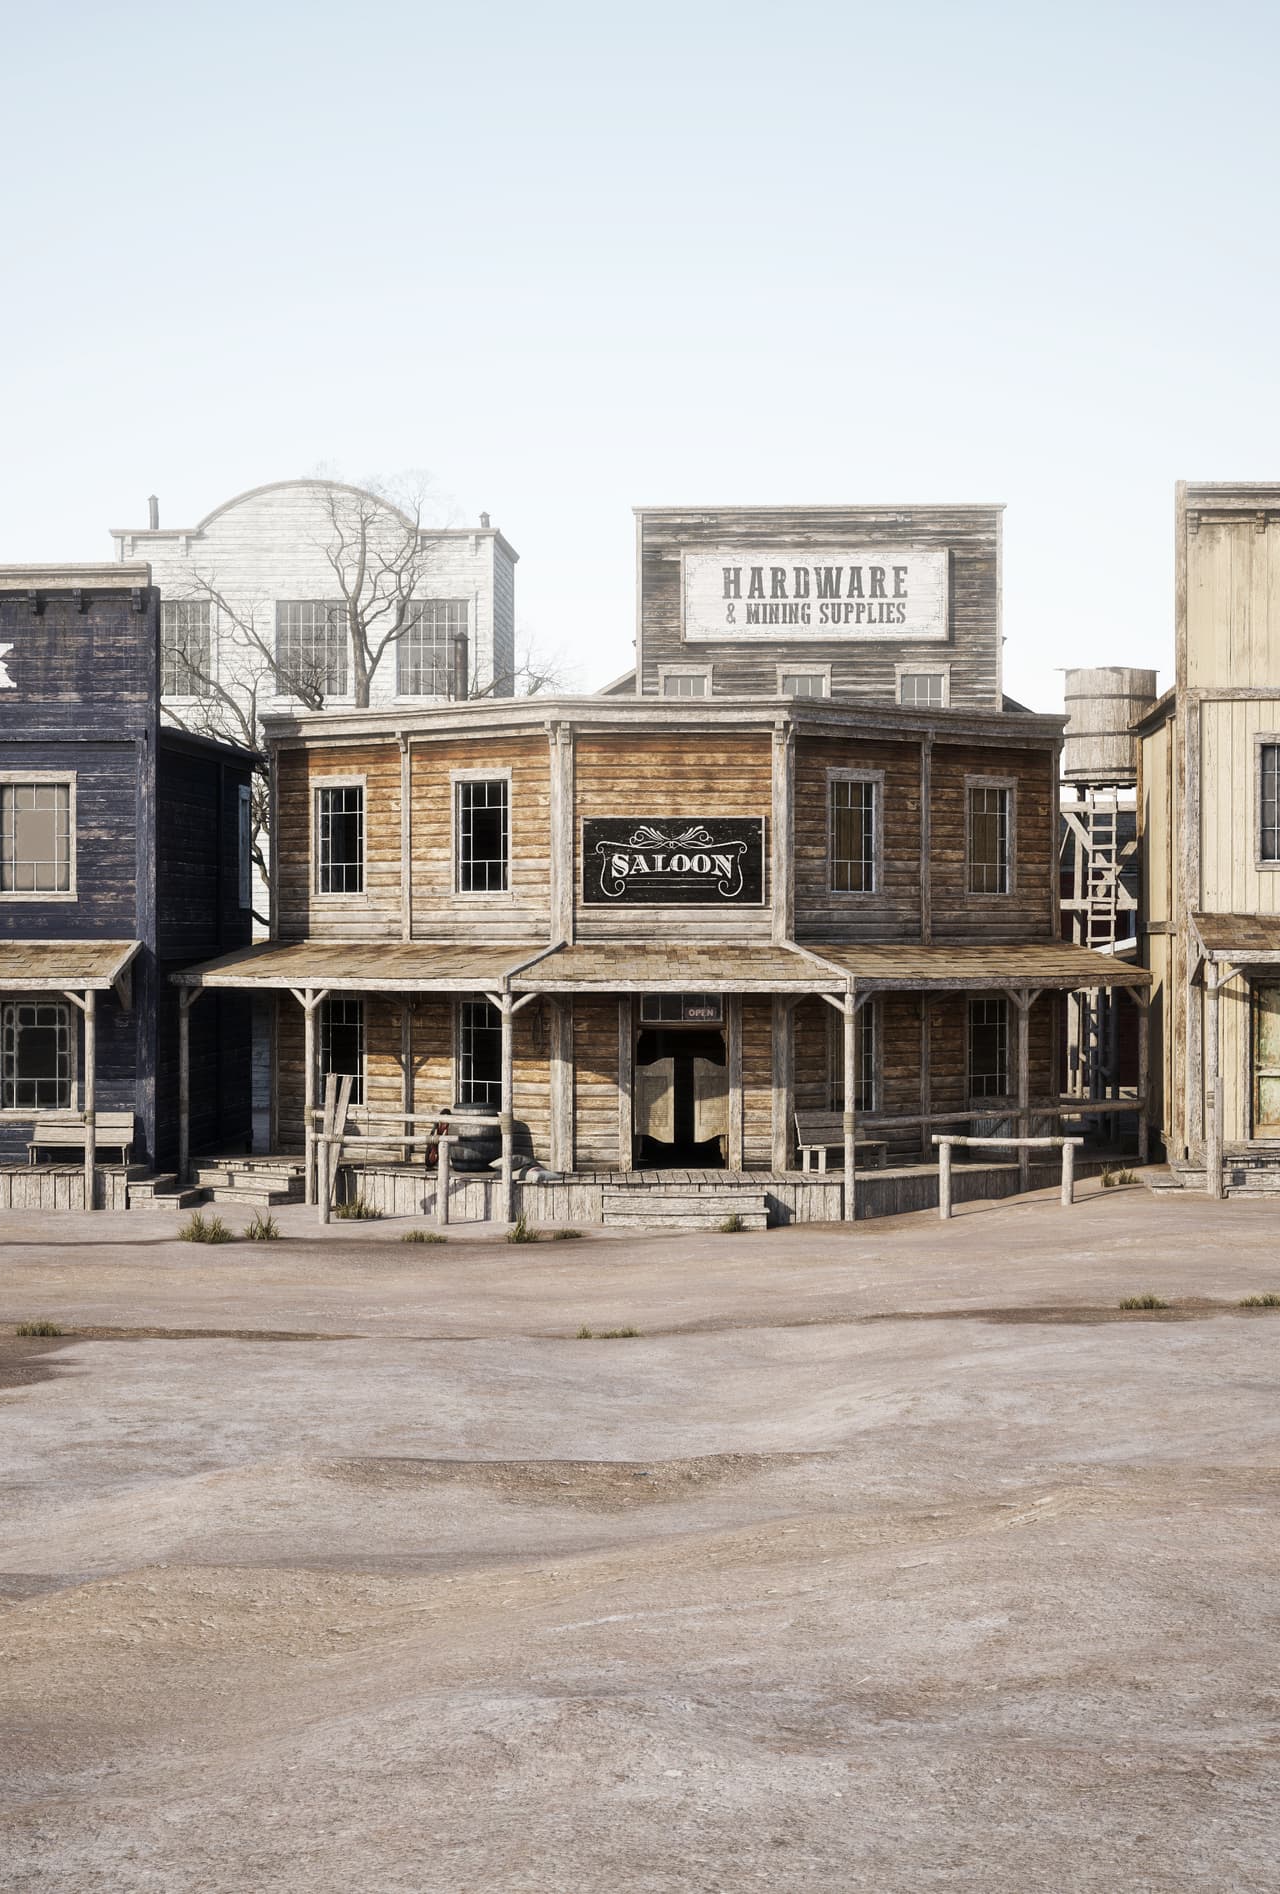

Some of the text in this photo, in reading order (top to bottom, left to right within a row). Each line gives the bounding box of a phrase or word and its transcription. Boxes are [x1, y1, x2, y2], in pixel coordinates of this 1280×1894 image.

[722, 566, 908, 599] HARDWARE
[726, 602, 906, 624] & MINING SUPPLIES
[611, 853, 735, 879] SALOON
[688, 1008, 714, 1017] OPEN
